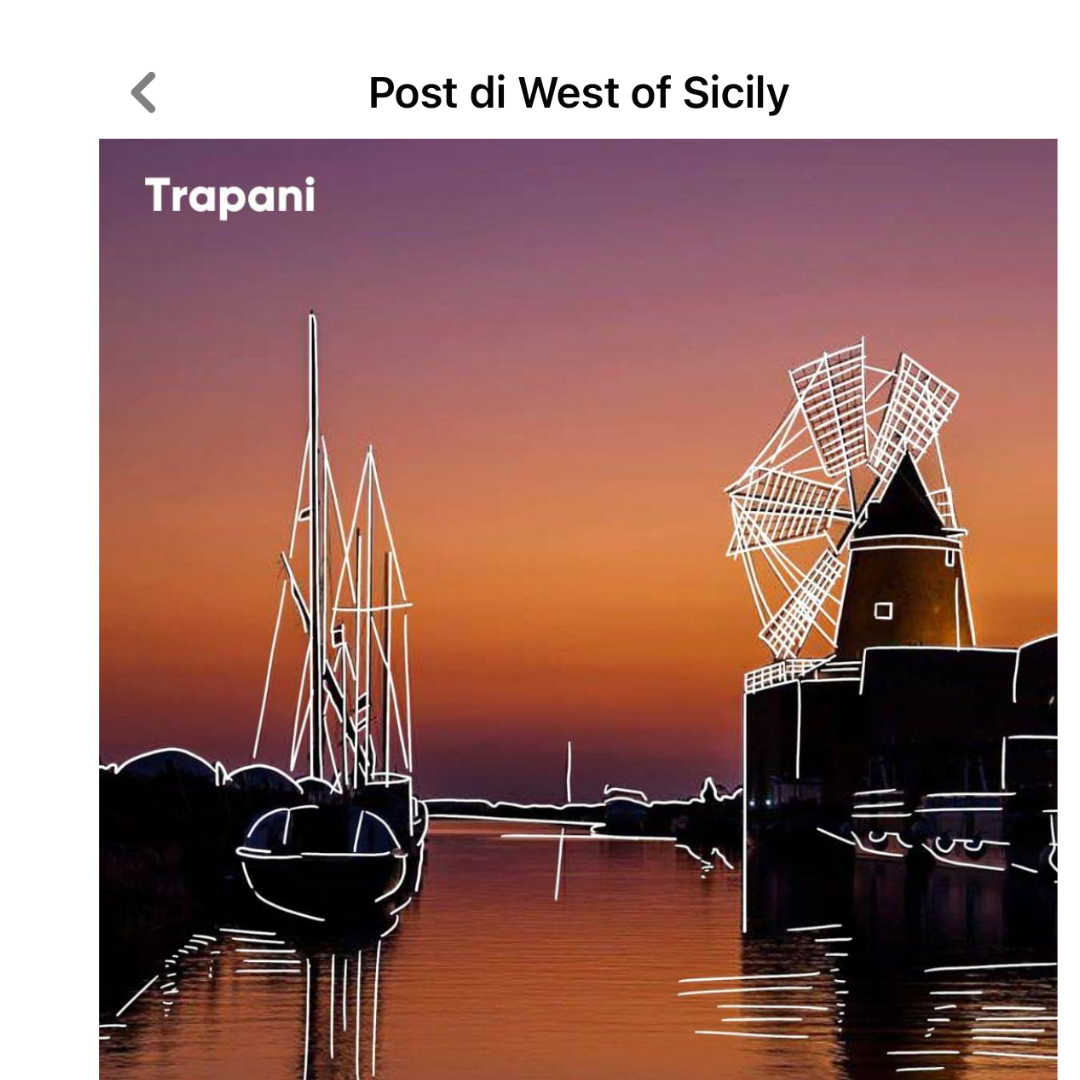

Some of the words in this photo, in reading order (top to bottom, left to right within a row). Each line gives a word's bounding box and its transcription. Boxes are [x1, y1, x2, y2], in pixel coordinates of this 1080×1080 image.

[370, 76, 458, 110] Post
[470, 73, 506, 109] di
[517, 76, 620, 110] West
[631, 74, 672, 110] of
[683, 73, 790, 117] Sicily
